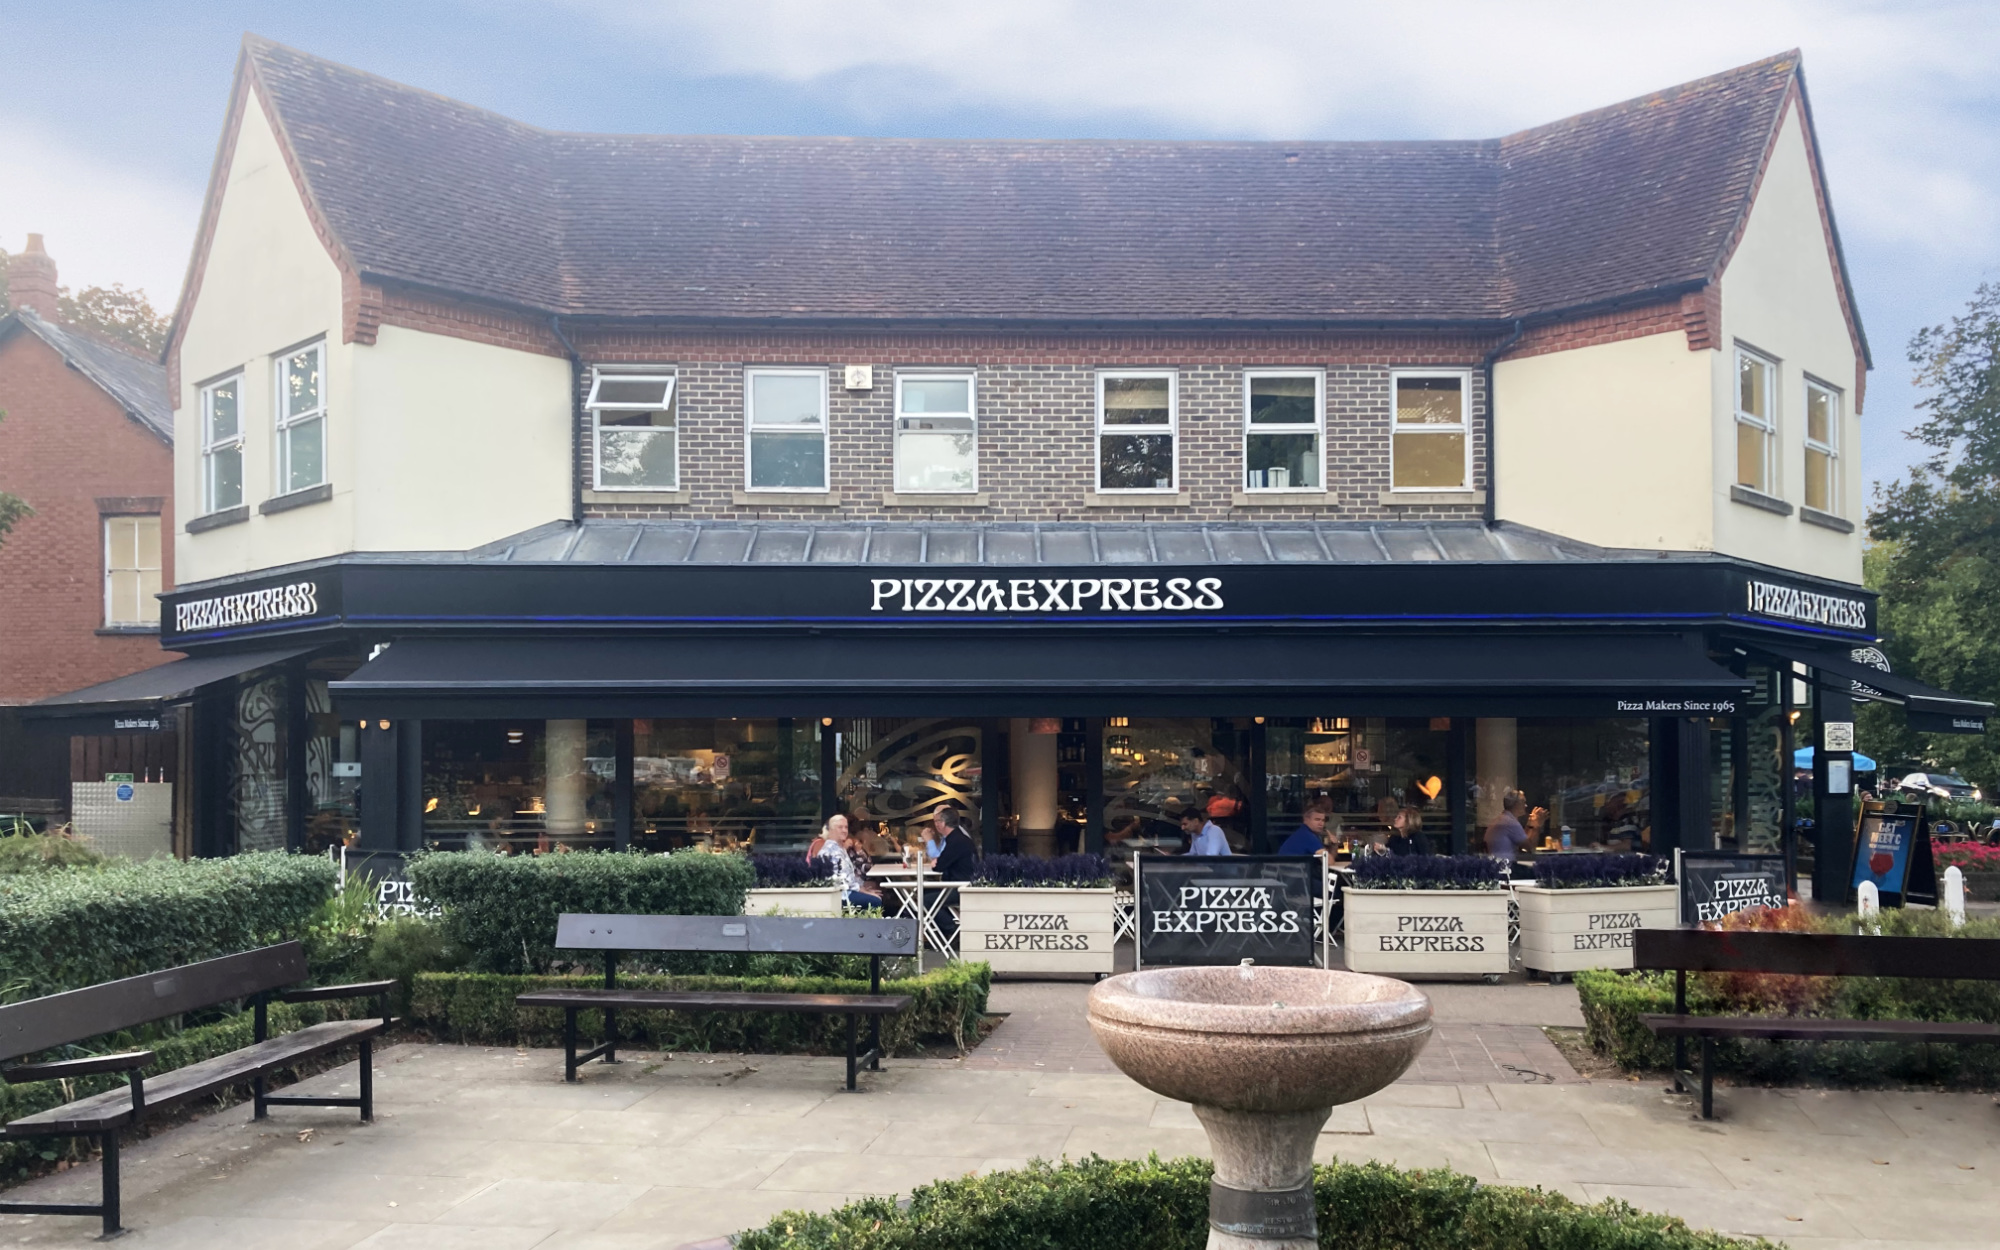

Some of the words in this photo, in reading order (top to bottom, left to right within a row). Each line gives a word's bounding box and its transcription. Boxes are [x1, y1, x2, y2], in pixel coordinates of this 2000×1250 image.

[870, 577, 1225, 612] PIZZAEXPRESS
[176, 582, 316, 631] PIZZAEXPRESS
[1748, 581, 1867, 629] PIZZAEXPRESS
[1617, 701, 1644, 711] Pizza
[1645, 700, 1682, 711] Makers
[1683, 700, 1711, 711] Since
[1712, 701, 1735, 712] 1965
[1713, 878, 1769, 899] PIZZA
[1179, 887, 1272, 909] PIZZA
[1003, 914, 1069, 930] PIZZA
[1152, 911, 1300, 933] EXPRESS
[1397, 916, 1464, 932] PIZZA
[1588, 913, 1642, 930] PIZZA
[984, 934, 1089, 950] EXPRESS
[1379, 936, 1485, 952] EXPRESS
[1573, 932, 1633, 950] EXPRE
